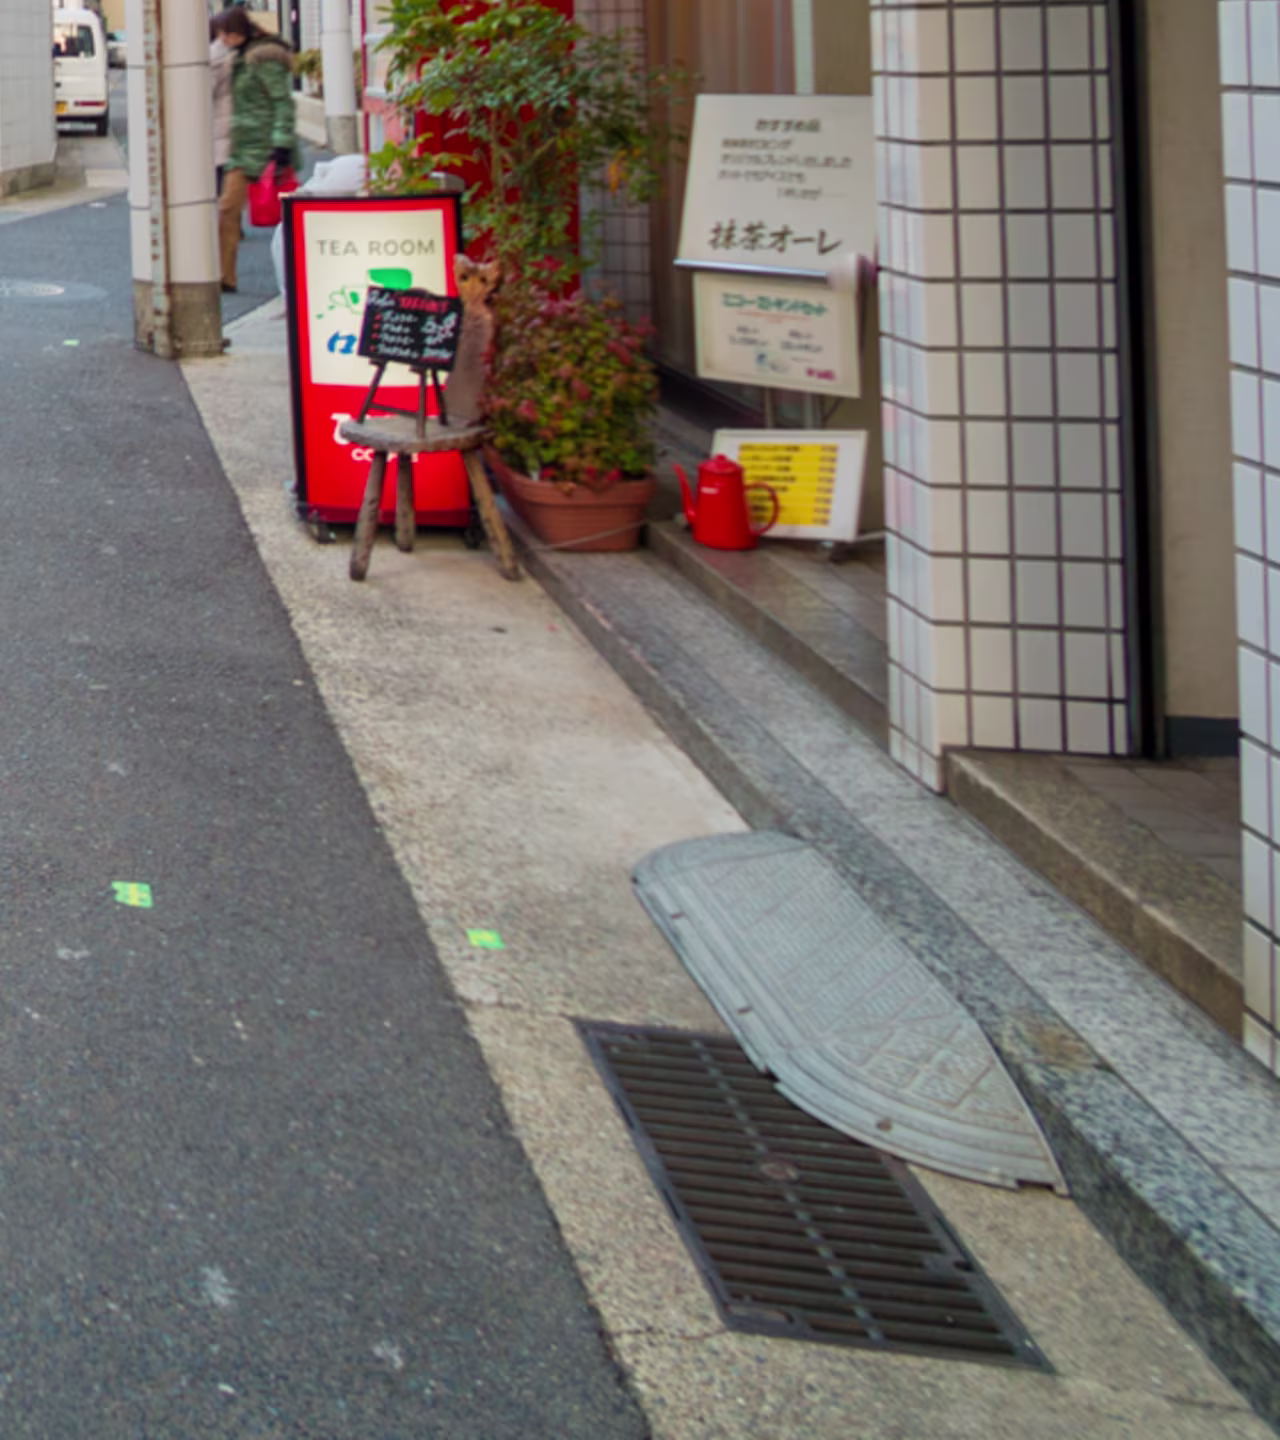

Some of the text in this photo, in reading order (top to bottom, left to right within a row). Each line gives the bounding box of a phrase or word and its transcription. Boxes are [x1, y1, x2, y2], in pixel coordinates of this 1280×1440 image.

[316, 238, 436, 257] TEA ROOM
[708, 219, 842, 255] 抹茶オーレ
